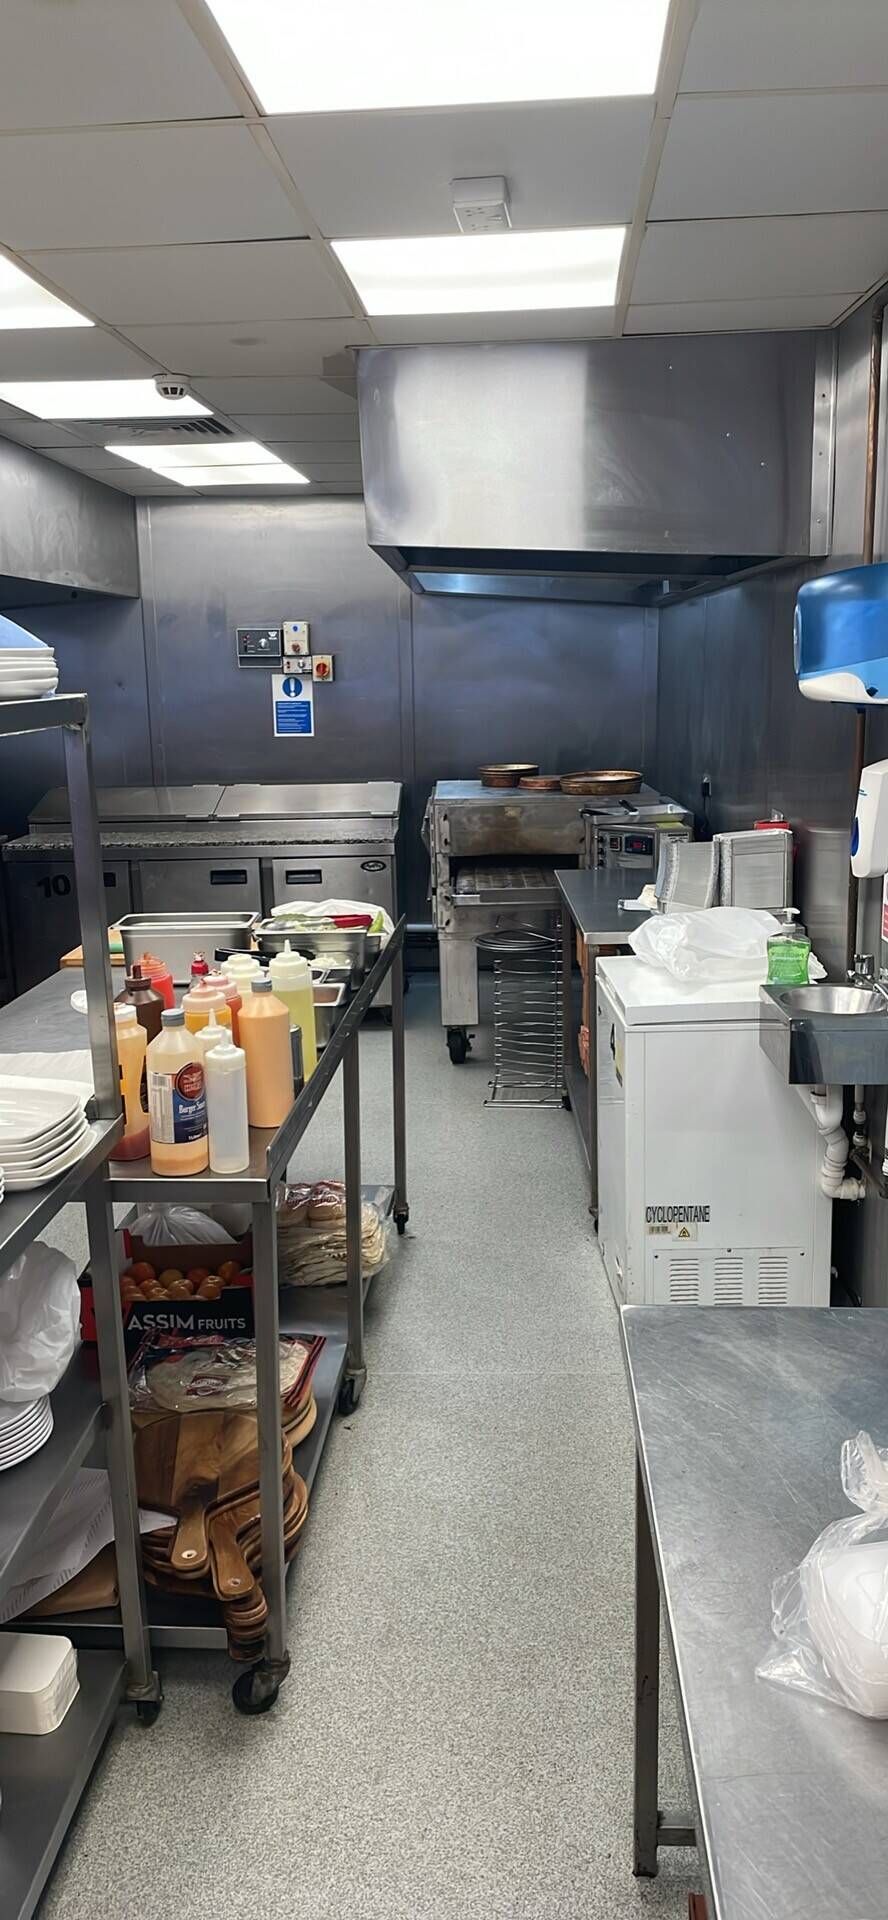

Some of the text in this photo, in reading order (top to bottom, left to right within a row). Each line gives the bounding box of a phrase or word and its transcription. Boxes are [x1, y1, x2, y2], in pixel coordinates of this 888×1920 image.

[37, 874, 71, 898] 10
[178, 1104, 197, 1114] Burger
[645, 1205, 710, 1223] CYCLOPENTANE
[127, 1314, 246, 1330] ASSIM FRUITS
